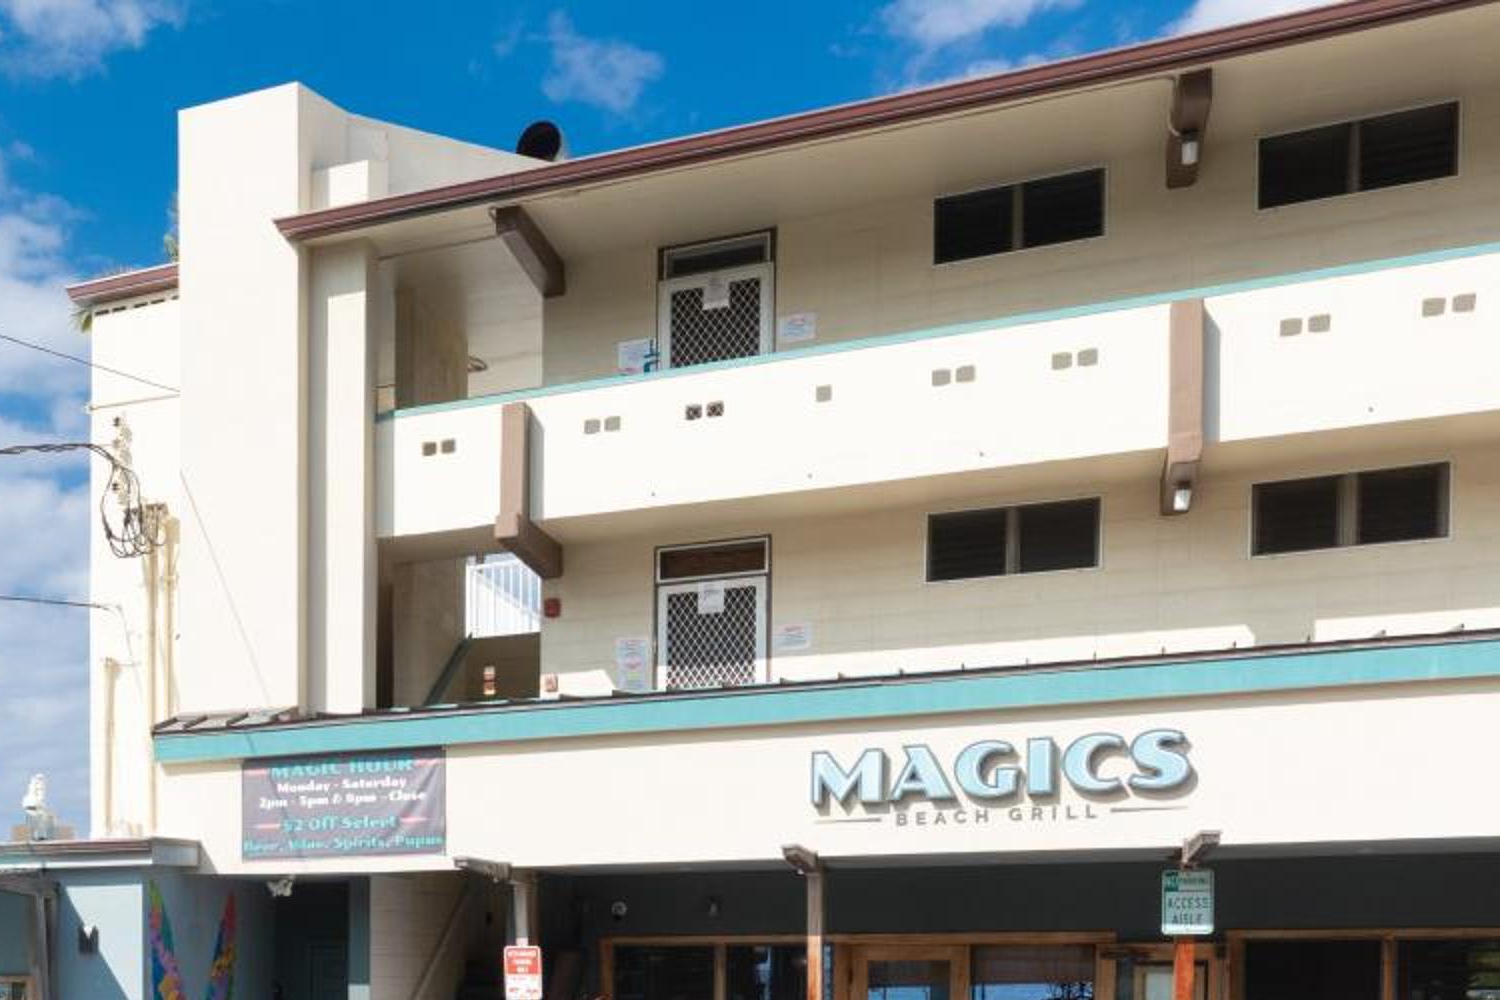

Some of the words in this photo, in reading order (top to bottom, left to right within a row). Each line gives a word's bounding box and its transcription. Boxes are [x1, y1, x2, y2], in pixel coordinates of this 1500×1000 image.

[270, 758, 341, 778] MAGIC
[350, 755, 415, 774] HOUR
[811, 728, 1194, 808] MAGICS
[276, 779, 330, 793] Monday
[341, 776, 407, 790] Saturday
[341, 813, 397, 829] Select
[896, 809, 990, 826] BEACH
[1008, 803, 1098, 821] GRILL
[1167, 896, 1211, 909] ACCESS
[1172, 913, 1204, 925] AISLE
